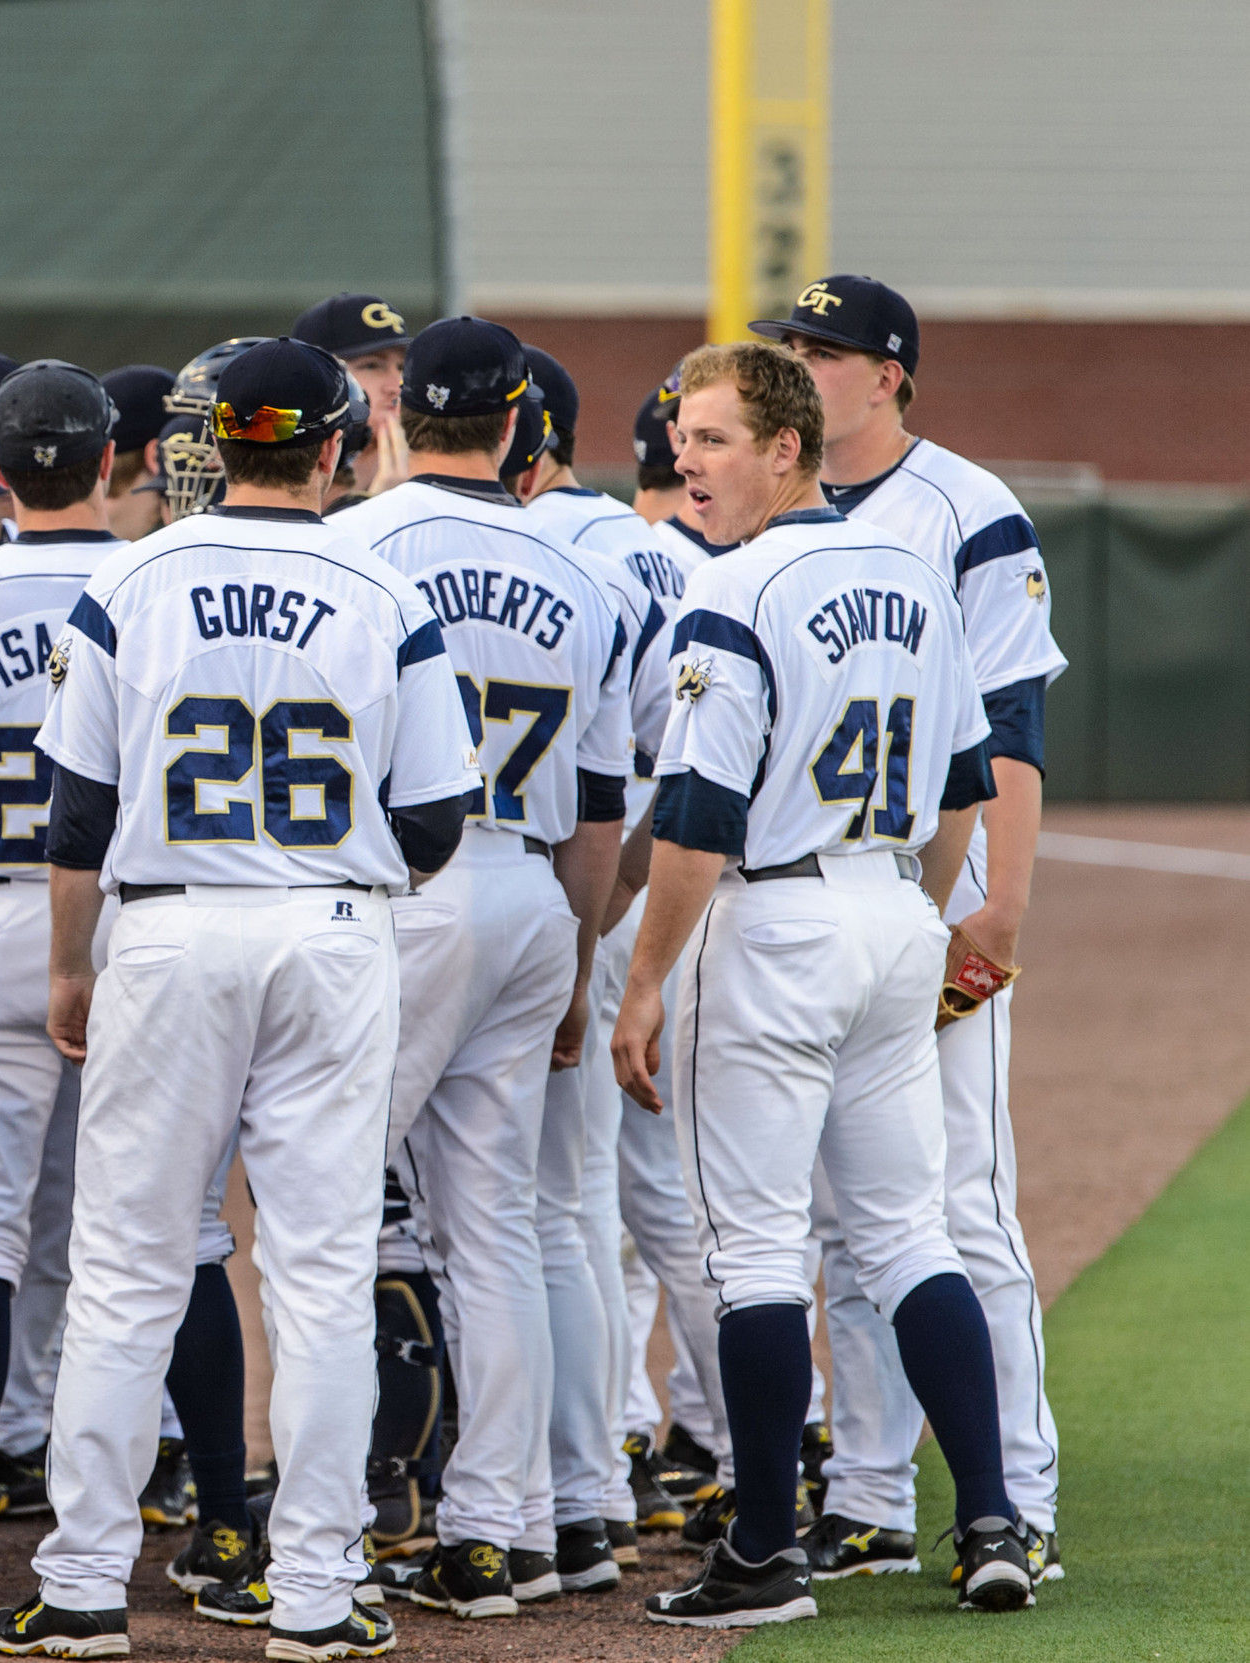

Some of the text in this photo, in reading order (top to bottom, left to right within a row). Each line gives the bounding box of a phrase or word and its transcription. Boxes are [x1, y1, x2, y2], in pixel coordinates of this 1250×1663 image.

[796, 281, 843, 317] GT
[190, 583, 336, 651] GORST
[806, 587, 929, 666] STANTON
[163, 693, 355, 851] 26
[807, 693, 918, 844] 41
